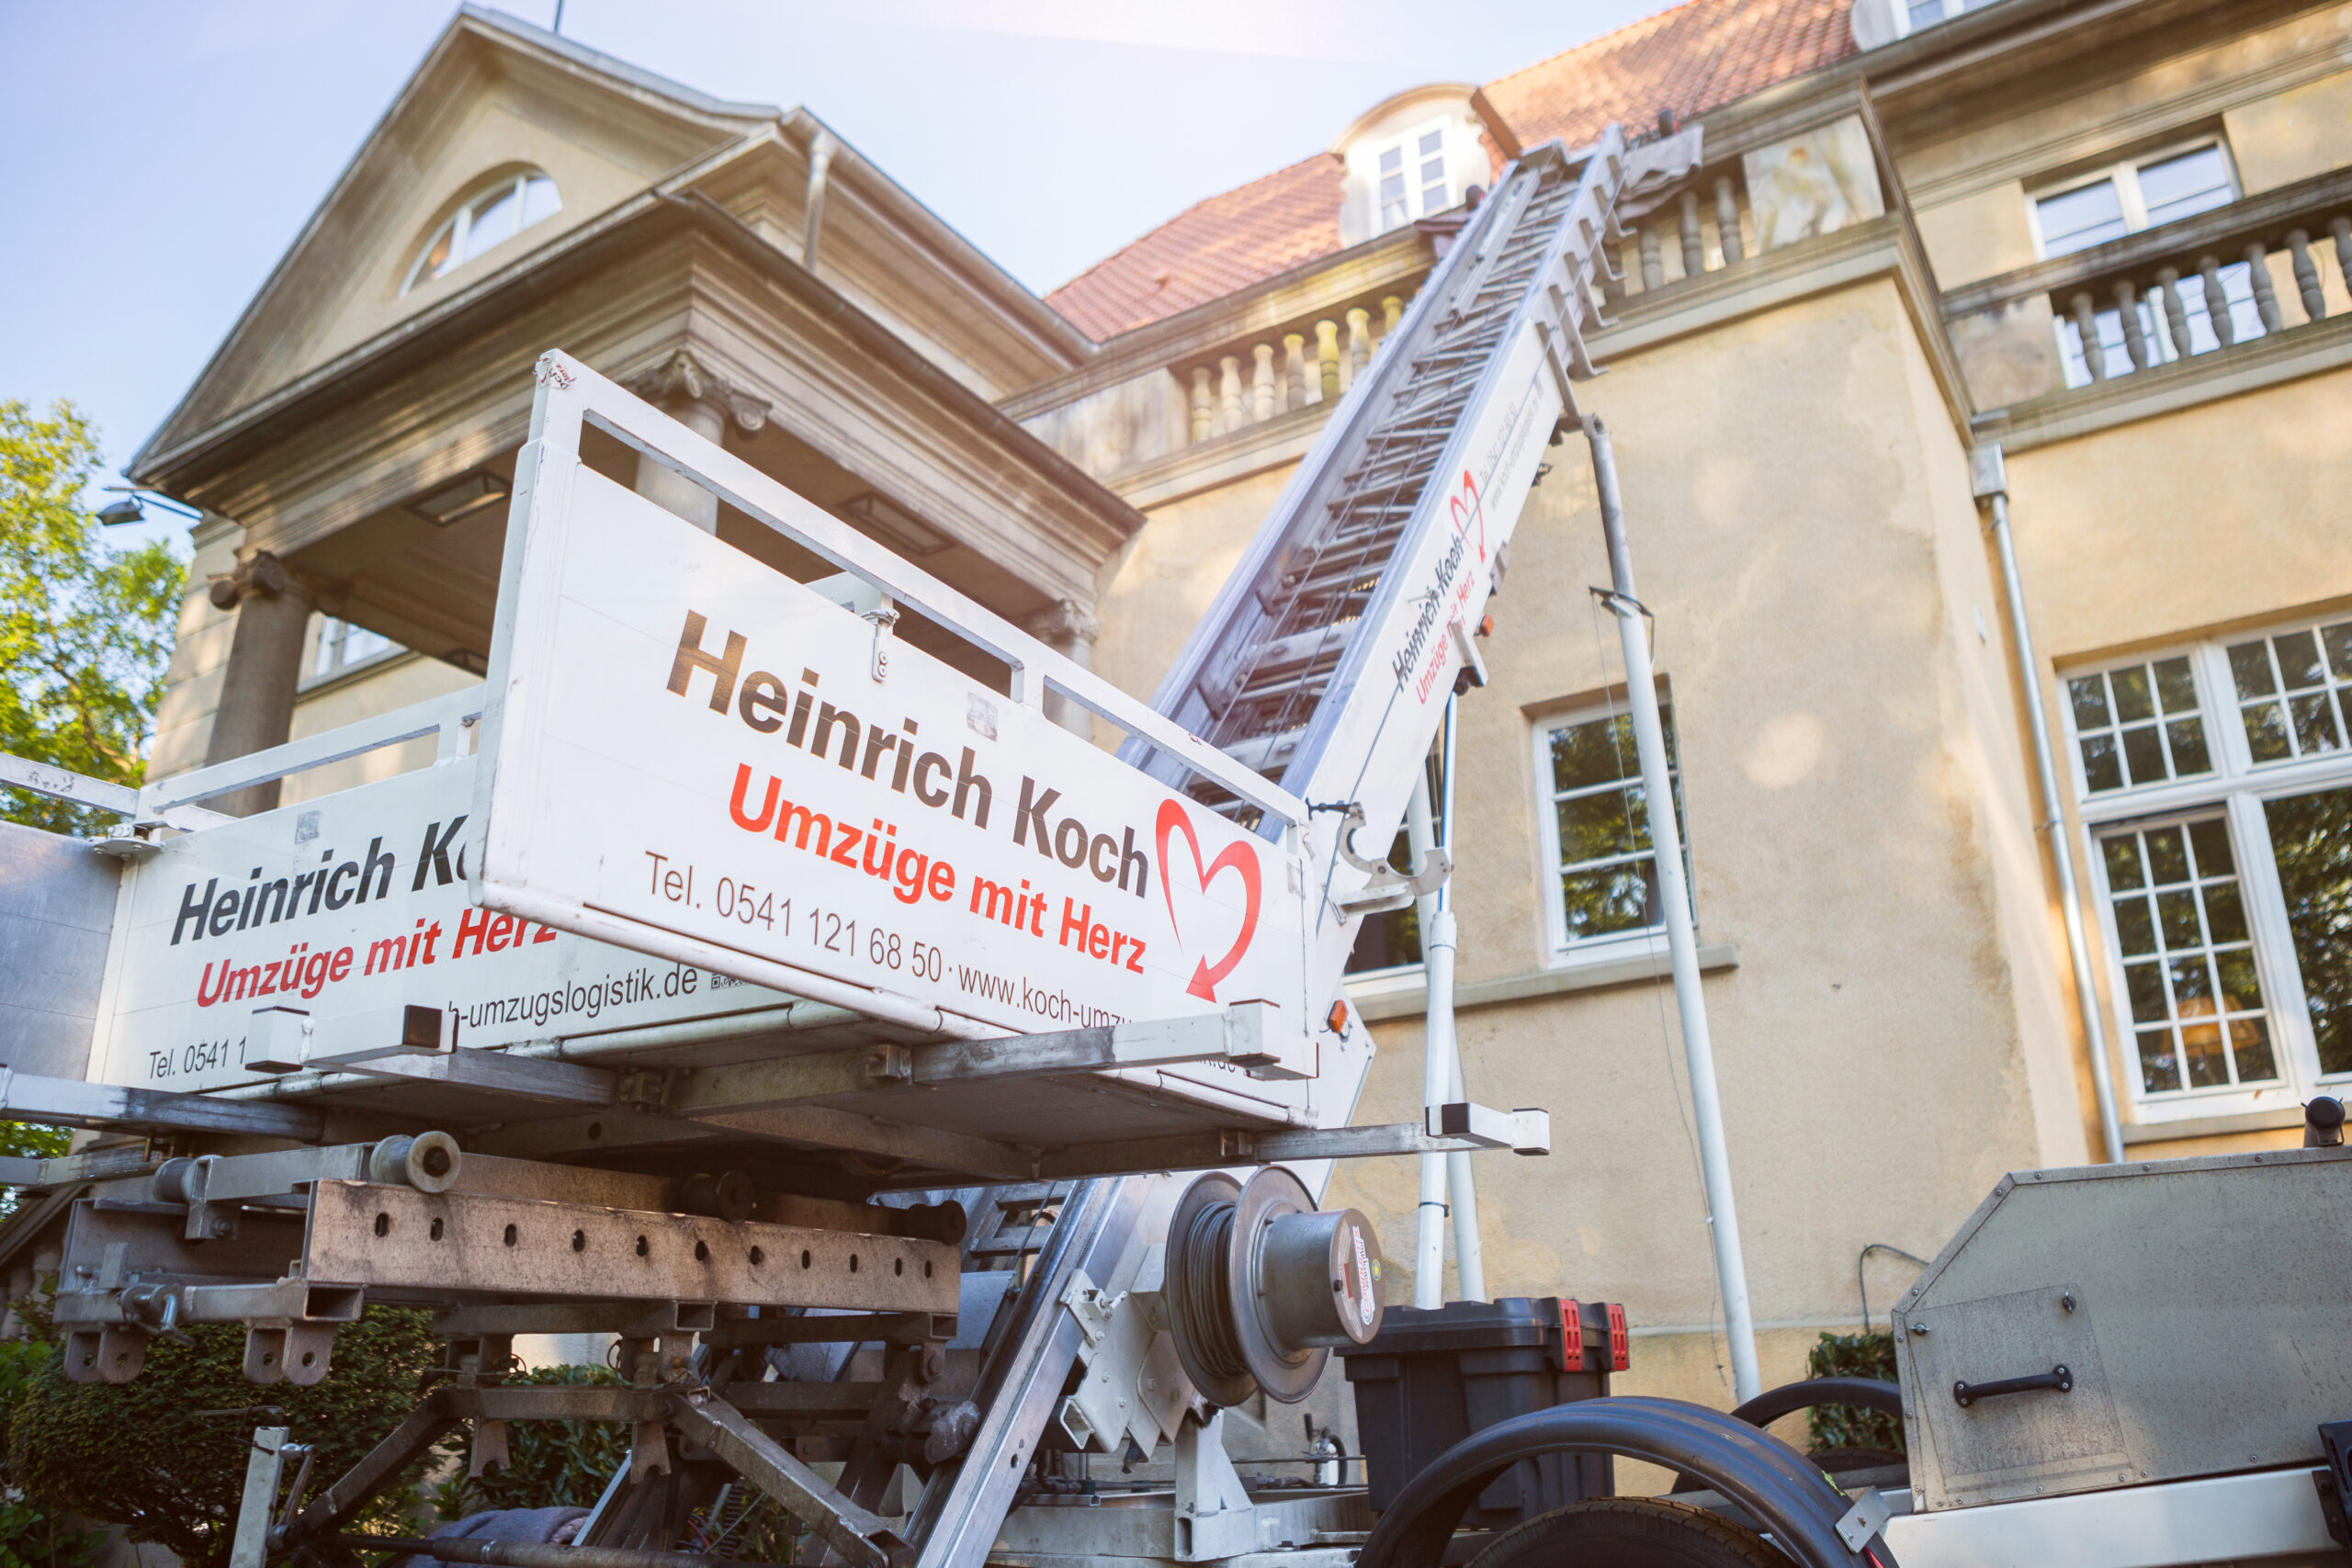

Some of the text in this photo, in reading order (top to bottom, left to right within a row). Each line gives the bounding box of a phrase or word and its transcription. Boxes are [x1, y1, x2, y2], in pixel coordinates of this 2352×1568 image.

[1392, 533, 1464, 694] Heinrich Koch
[1416, 634, 1449, 705] Umzüge
[1456, 570, 1476, 611] Herz
[666, 609, 1148, 898] Heinrich Koch
[170, 815, 469, 946] Heinrich K
[645, 850, 1132, 1028] Tel. 0541 121 68 50 www.koch-umz
[729, 762, 1147, 975] Umzüge mit Herz
[197, 908, 558, 1008] Umzüge mit Herz
[149, 1051, 175, 1079] Tel.
[184, 1039, 229, 1074] 0541
[239, 1035, 247, 1065] 1
